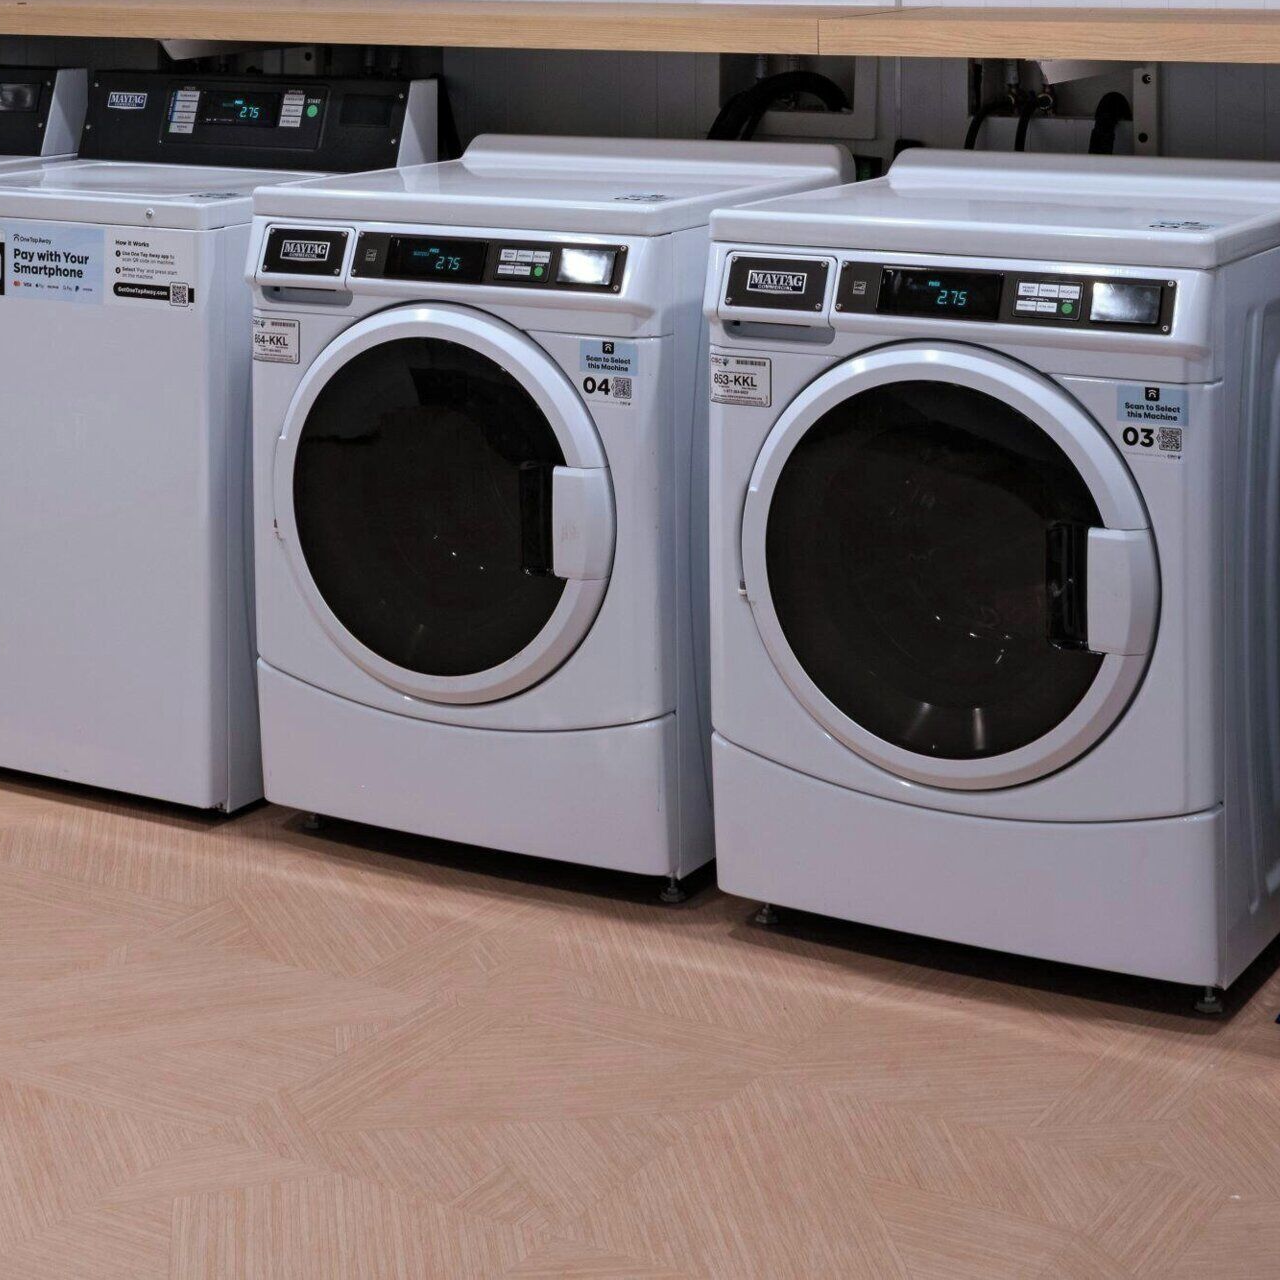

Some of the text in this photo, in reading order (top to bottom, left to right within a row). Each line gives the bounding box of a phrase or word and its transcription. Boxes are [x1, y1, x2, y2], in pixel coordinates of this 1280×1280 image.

[111, 94, 144, 104] MAYTAG
[239, 106, 260, 119] 2.75
[284, 242, 327, 254] MAYTAG
[13, 248, 89, 265] Pay with Your
[435, 256, 461, 270] 2.75
[13, 262, 83, 278] Smartphone
[751, 272, 804, 287] MAYTAG
[937, 290, 968, 305] 2.75
[601, 364, 629, 372] Machine
[610, 357, 631, 365] Select
[583, 376, 611, 395] 04
[713, 372, 758, 387] 853-KKL
[1124, 402, 1145, 410] Scan
[1155, 404, 1181, 413] Select
[1127, 411, 1178, 421] this Machine
[1122, 426, 1155, 448] 03
